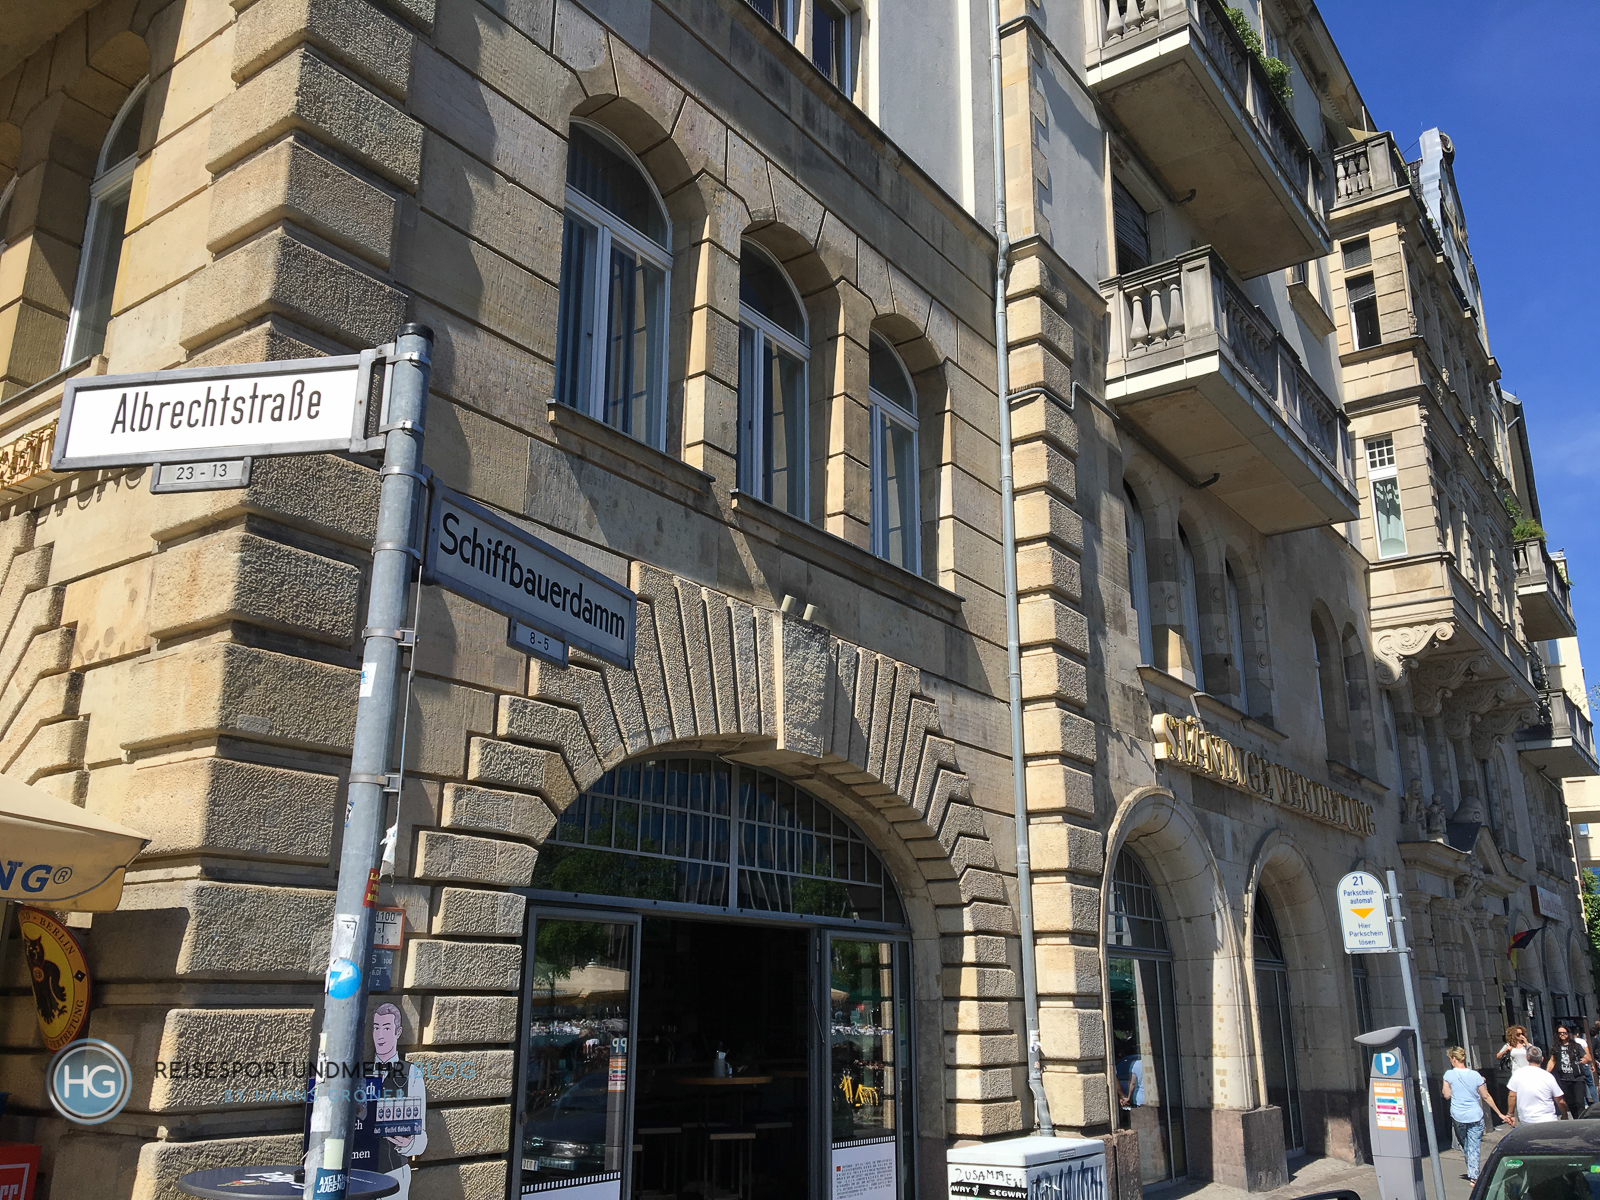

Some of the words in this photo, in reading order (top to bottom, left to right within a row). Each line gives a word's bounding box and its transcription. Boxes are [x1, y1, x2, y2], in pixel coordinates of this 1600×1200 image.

[110, 379, 322, 435] Albrechtstraße
[176, 466, 194, 481] 23
[212, 463, 228, 479] 13
[440, 512, 625, 640] Schiffbauerdamm
[1352, 875, 1364, 886] 21
[1343, 889, 1377, 897] Parkschein-
[39, 917, 75, 955] BERLIN
[316, 1181, 345, 1194] JUGEND
[989, 1188, 1027, 1200] SEGWAY
